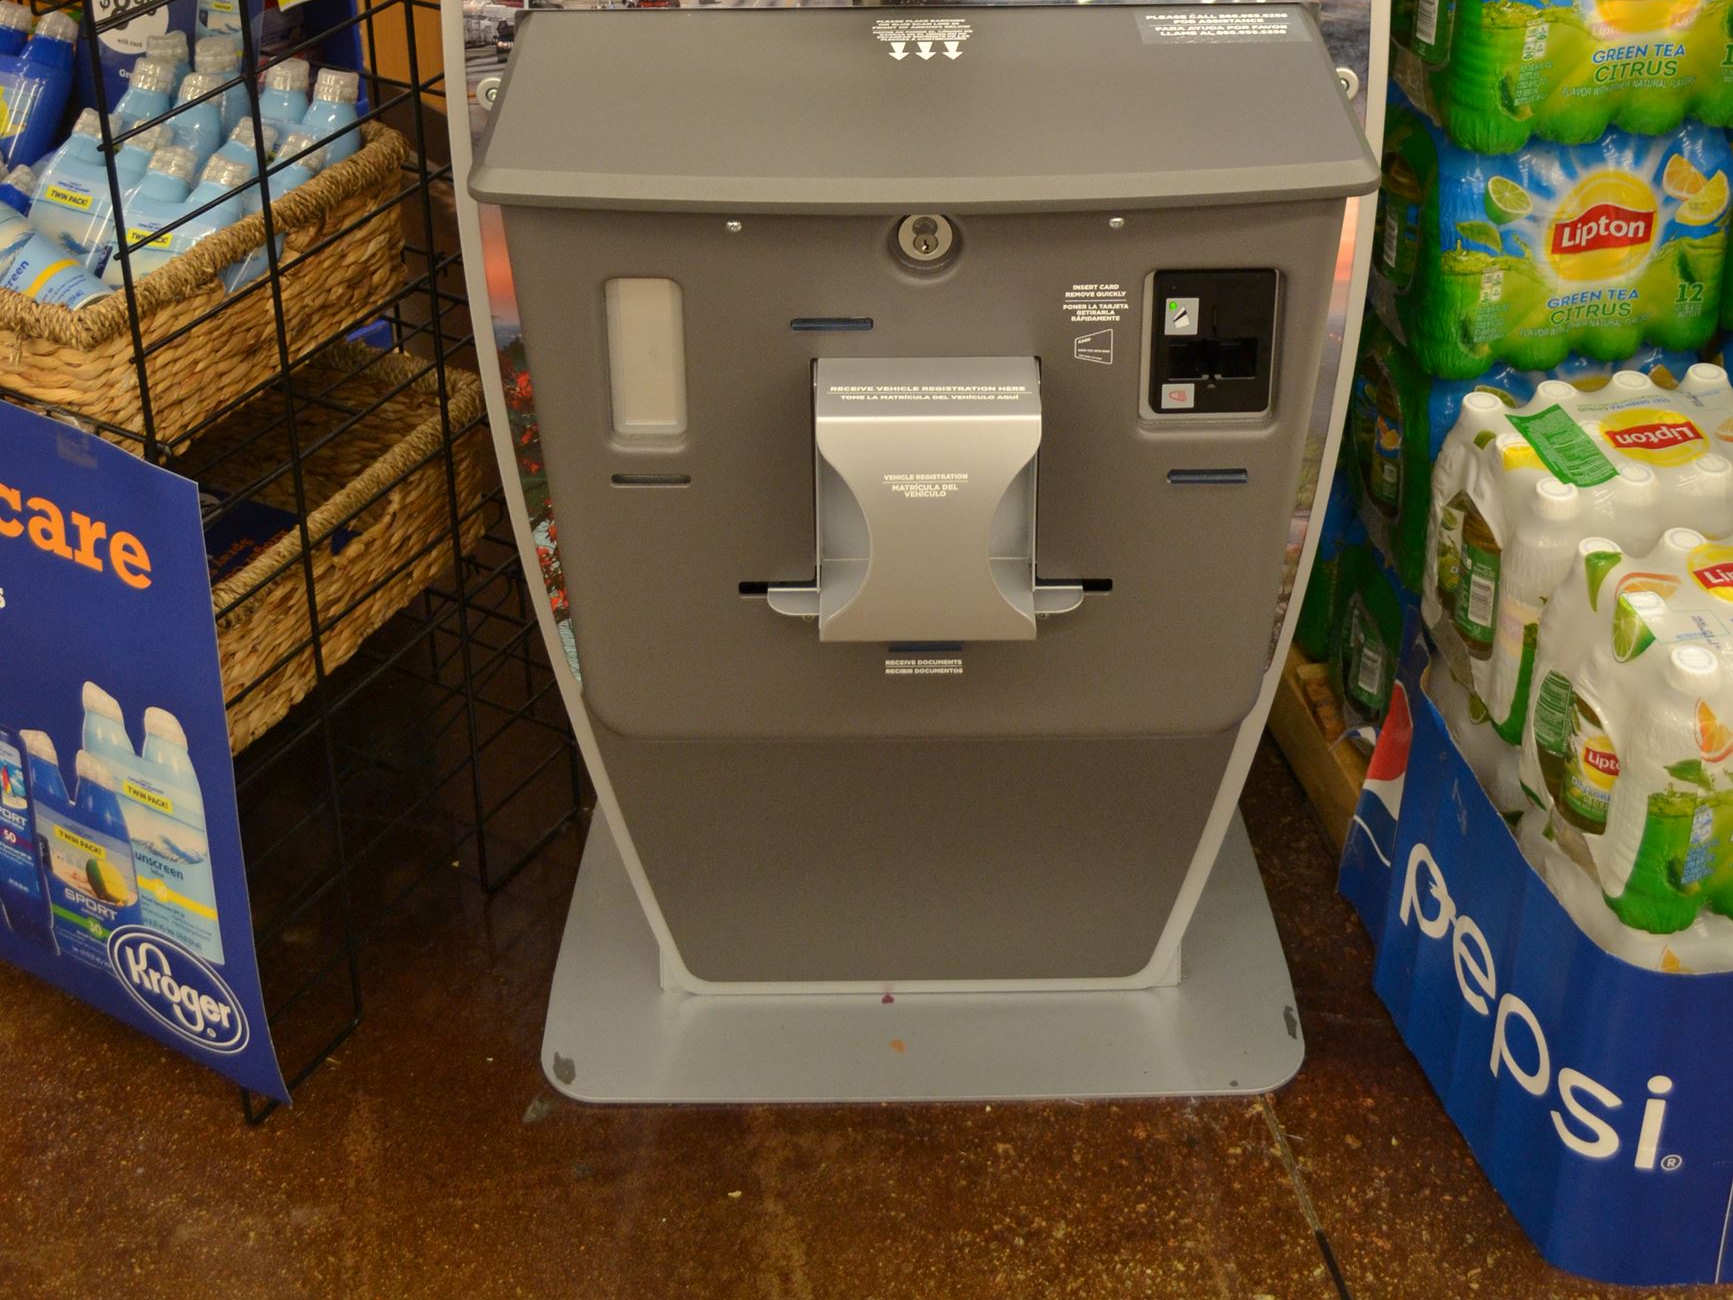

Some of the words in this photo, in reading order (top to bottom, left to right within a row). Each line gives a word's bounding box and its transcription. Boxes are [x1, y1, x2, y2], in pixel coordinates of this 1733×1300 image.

[1592, 44, 1648, 64] GREEN
[1655, 43, 1685, 57] TEA
[1594, 60, 1678, 83] CITRUS
[51, 189, 68, 201] TWIN
[69, 194, 89, 206] PACK!
[1561, 217, 1646, 249] Lipton
[1547, 289, 1601, 309] GREEN
[1608, 288, 1639, 300] TEA
[1674, 283, 1705, 304] 12
[1550, 302, 1632, 324] CITRUS
[1615, 425, 1695, 444] Lipton
[127, 785, 146, 799] TWIN
[147, 795, 169, 810] PACK!
[3, 830, 17, 844] 50
[58, 829, 79, 844] TWIN
[79, 838, 102, 855] PACK!
[64, 887, 118, 921] SPORT
[126, 943, 231, 1035] Kroger
[1400, 842, 1673, 1170] pepsi
